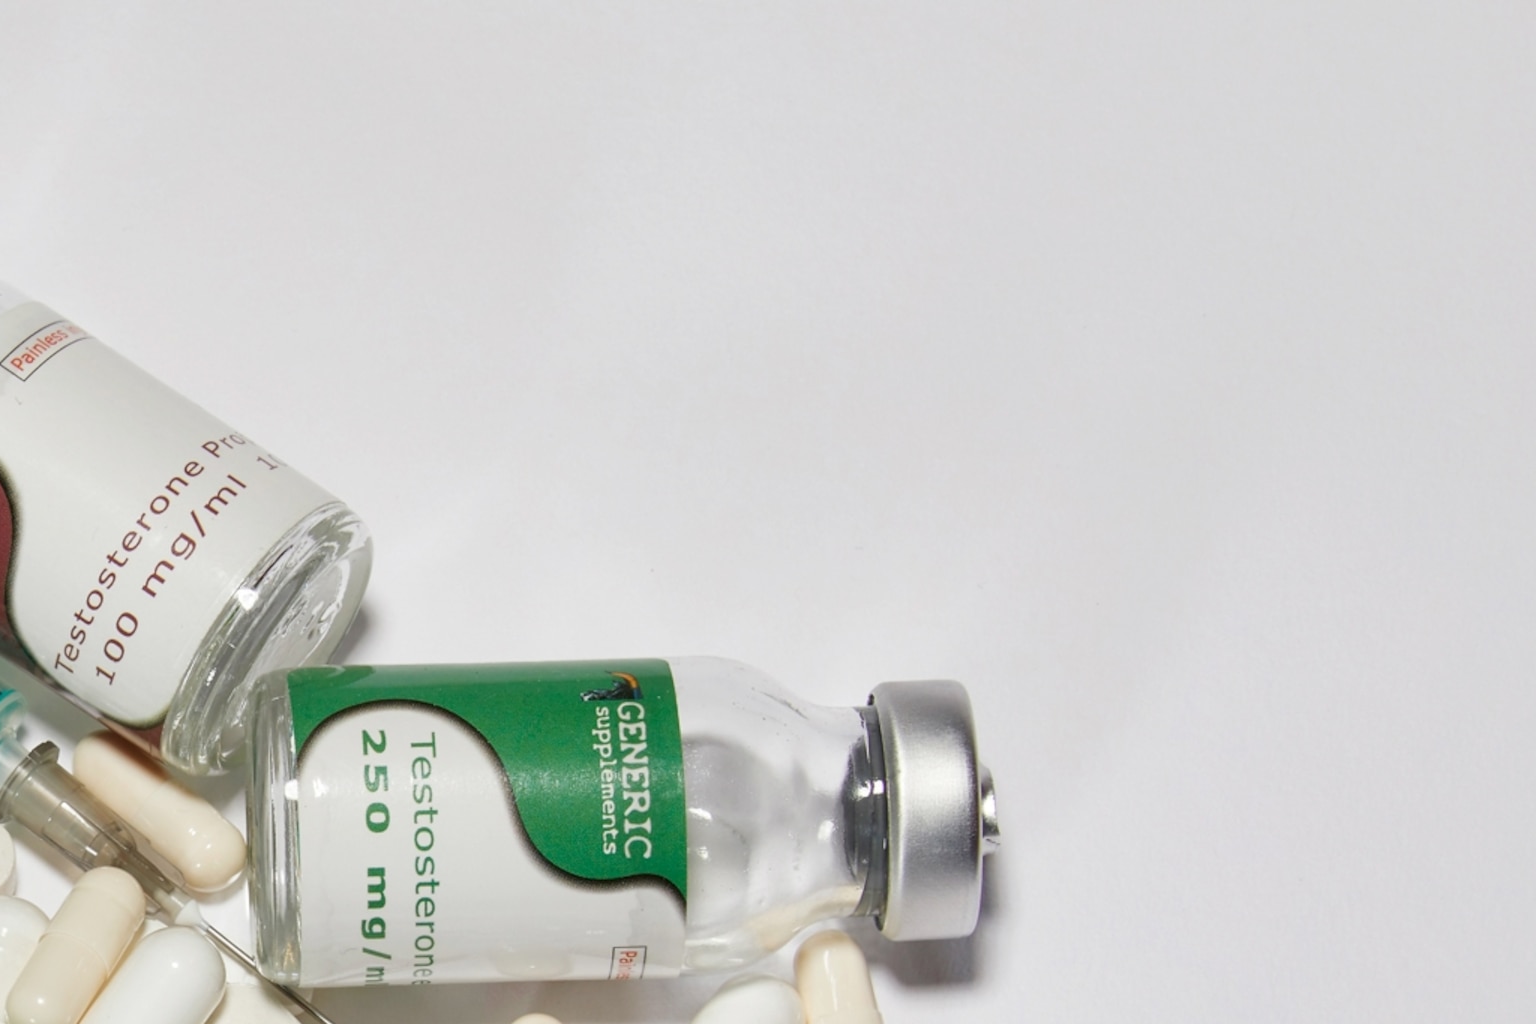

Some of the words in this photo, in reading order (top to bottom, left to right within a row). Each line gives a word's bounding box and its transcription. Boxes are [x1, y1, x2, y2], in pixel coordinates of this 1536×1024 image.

[10, 329, 68, 371] Painless
[54, 460, 205, 675] Testosterone
[96, 611, 139, 685] 100
[142, 474, 247, 598] mg/ml
[361, 729, 391, 834] 250
[410, 731, 440, 979] Testosterone
[591, 706, 618, 856] supplements
[617, 701, 652, 860] GENERIC
